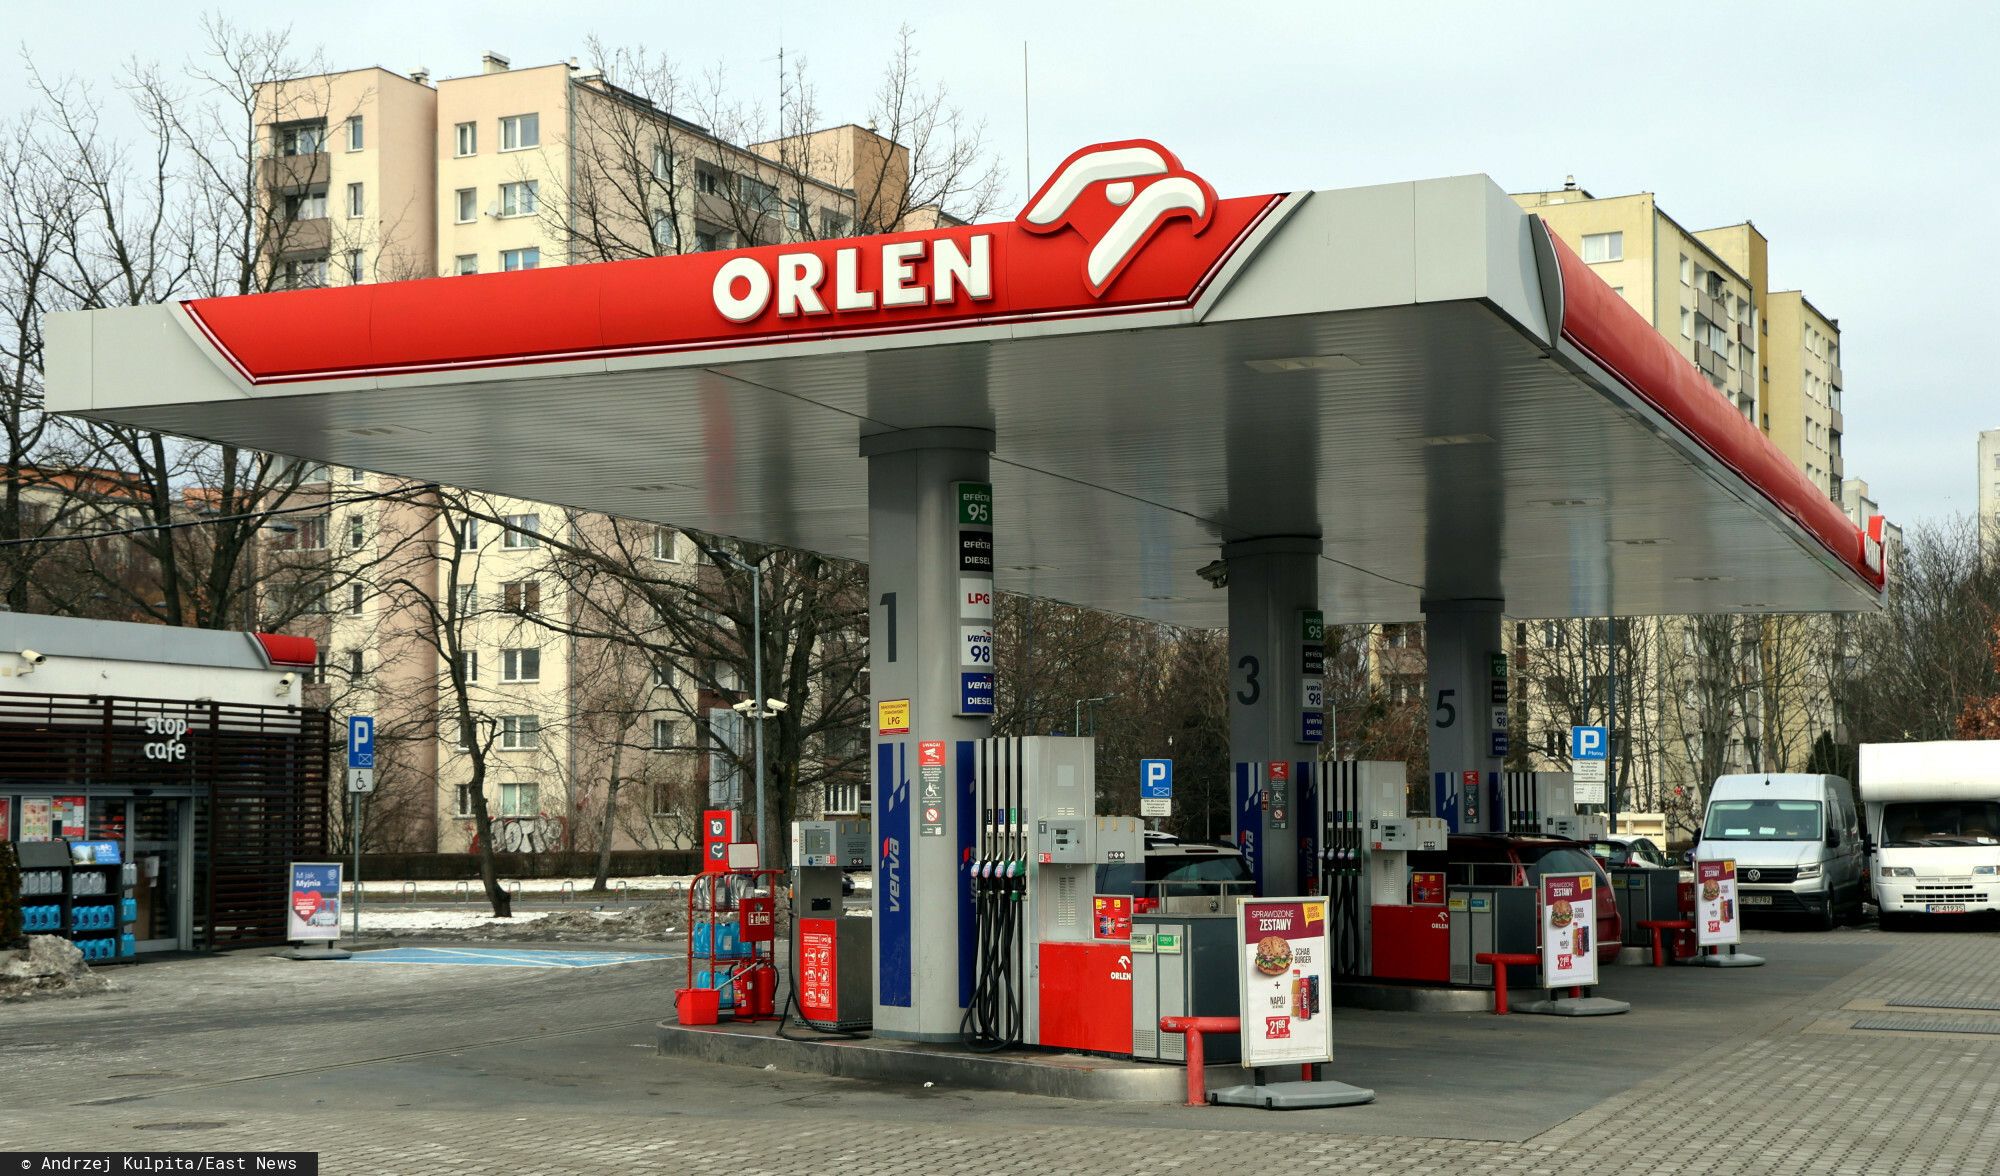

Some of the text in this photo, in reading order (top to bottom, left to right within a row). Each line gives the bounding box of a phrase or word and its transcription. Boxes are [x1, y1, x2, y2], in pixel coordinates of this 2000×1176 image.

[712, 234, 992, 323] ORLEN
[967, 504, 988, 521] 95
[964, 556, 991, 565] DIESEL
[967, 592, 991, 605] LPG
[879, 591, 897, 662] 1
[1308, 625, 1322, 639] 95
[967, 633, 992, 643] verva
[970, 645, 991, 663] 98
[967, 681, 992, 690] verva
[1236, 654, 1260, 706] 3
[967, 697, 992, 706] DIESEL
[1308, 693, 1321, 705] 98
[1435, 689, 1456, 728] 5
[887, 716, 901, 726] LPG
[354, 721, 369, 752] P
[1580, 730, 1600, 755] P
[144, 739, 187, 762] cafe
[1148, 763, 1166, 786] P
[889, 837, 900, 912] verva
[295, 880, 321, 888] Myjnia
[1252, 909, 1294, 919] SPRAWDZONE
[1260, 918, 1292, 931] ZESTAWY
[1295, 948, 1311, 956] SCHAB
[1295, 955, 1312, 964] BURGER
[1110, 971, 1132, 981] ORLEN
[1270, 995, 1286, 1005] NAPÓJ
